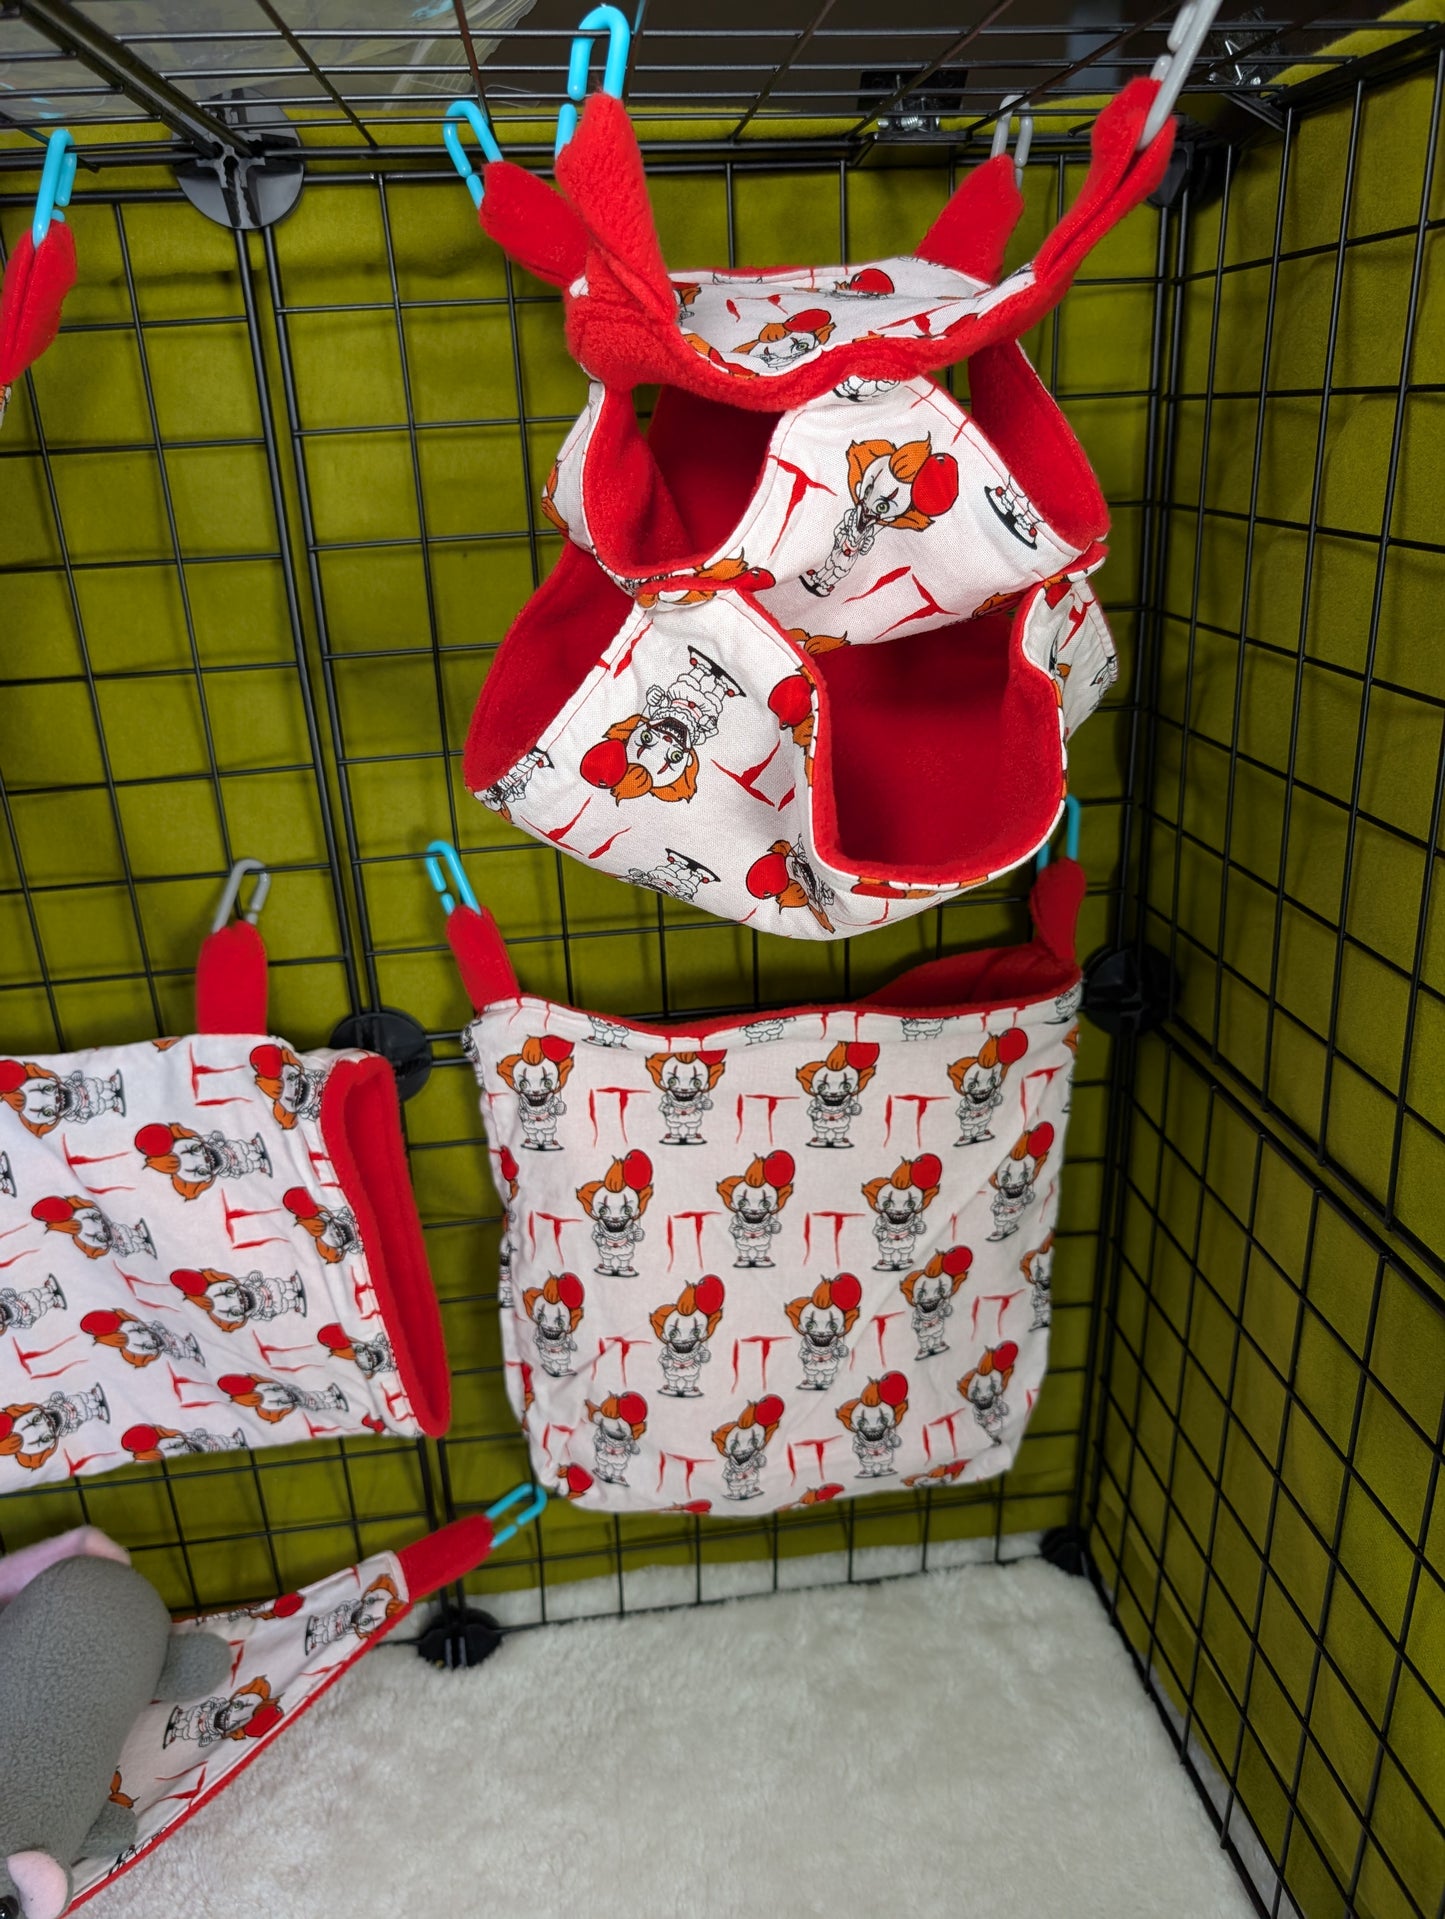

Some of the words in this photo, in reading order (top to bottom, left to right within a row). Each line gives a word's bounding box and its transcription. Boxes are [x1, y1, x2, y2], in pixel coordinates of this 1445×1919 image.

[842, 565, 960, 642] IT
[520, 794, 632, 859] IT
[188, 1042, 253, 1107] IT
[588, 1087, 651, 1147] IT
[736, 1093, 800, 1146] IT
[884, 1094, 950, 1148] IT
[62, 1133, 136, 1195] IT
[221, 1188, 290, 1251] IT
[528, 1210, 583, 1266] IT
[667, 1211, 723, 1273] IT
[803, 1211, 866, 1269] IT
[112, 1260, 181, 1312] IT
[971, 1288, 1026, 1342] IT
[12, 1334, 88, 1380] IT
[252, 1329, 325, 1373] IT
[591, 1336, 652, 1387] IT
[731, 1335, 792, 1394] IT
[167, 1360, 231, 1408] IT
[787, 1435, 843, 1487] IT
[922, 1408, 965, 1466] IT
[656, 1450, 716, 1498] IT
